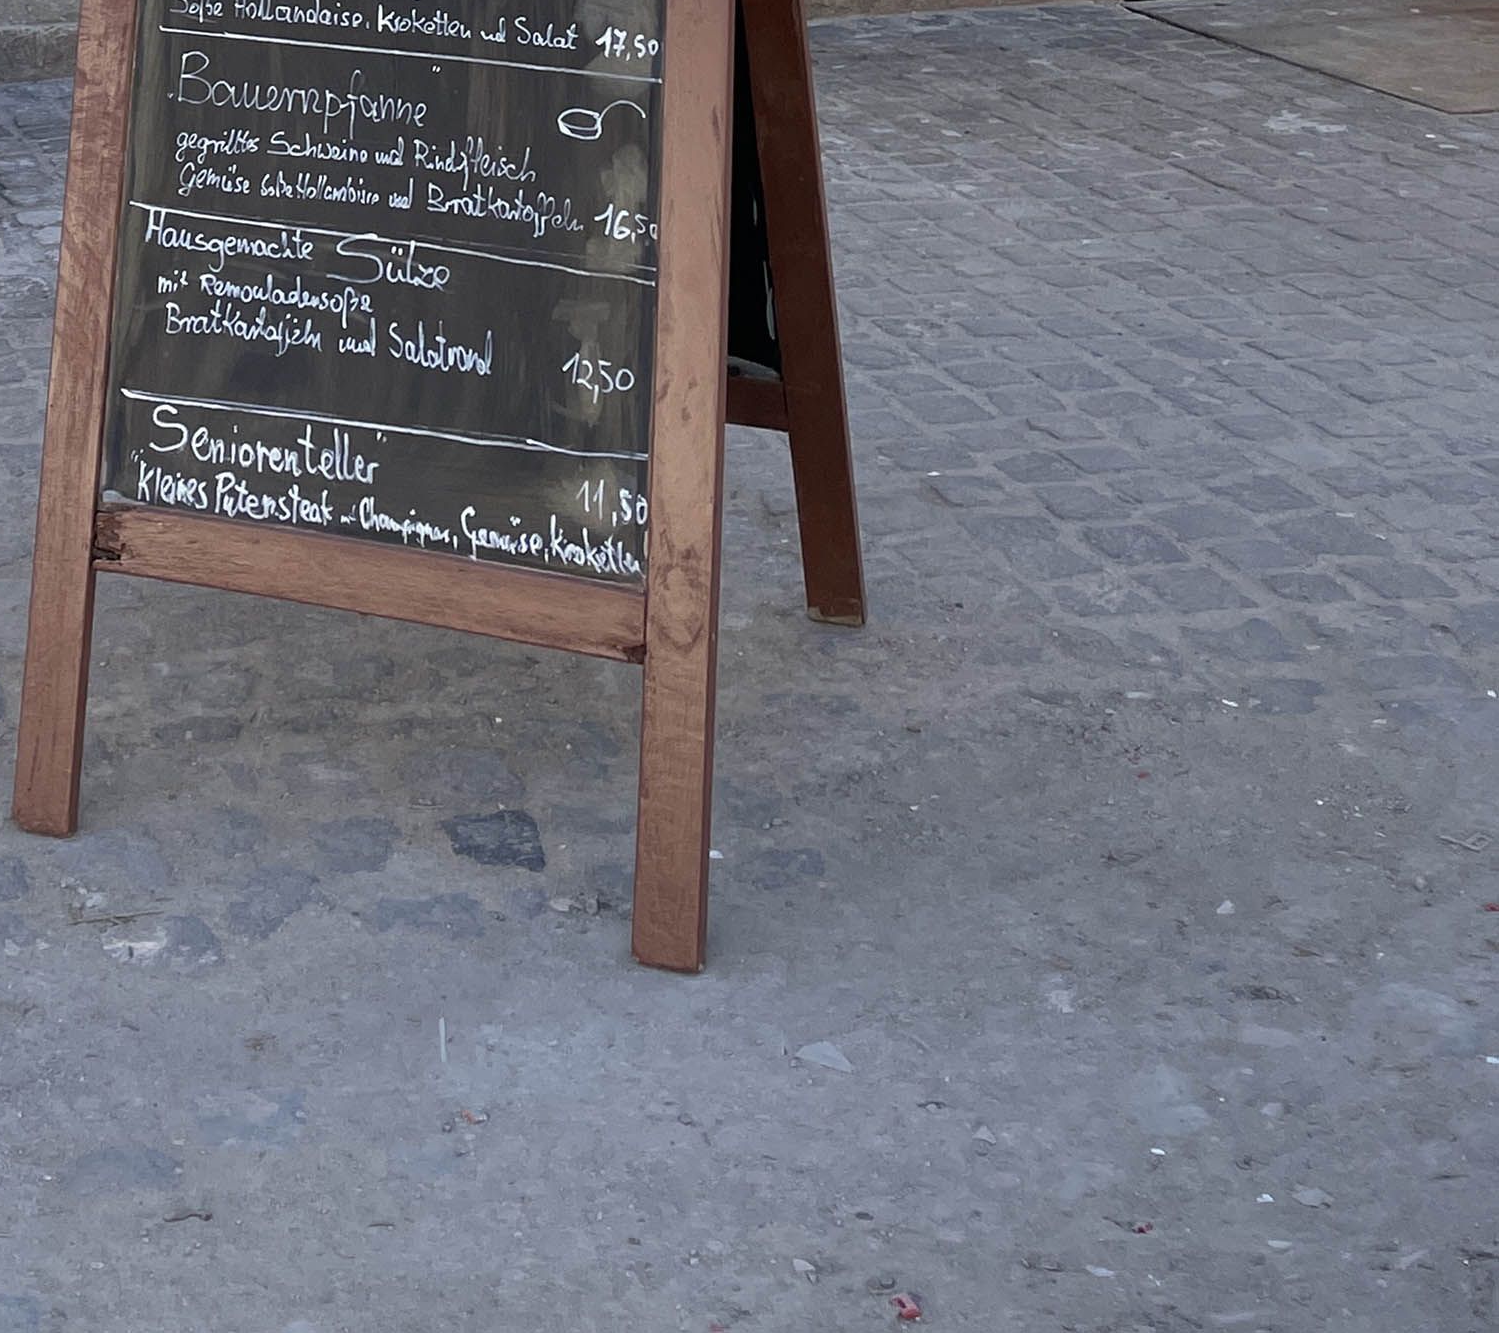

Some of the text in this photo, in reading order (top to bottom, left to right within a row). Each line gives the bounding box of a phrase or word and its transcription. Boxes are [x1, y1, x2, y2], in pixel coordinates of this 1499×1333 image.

[377, 4, 471, 40] Kroketten
[516, 16, 579, 50] Salat
[595, 25, 660, 62] 17,50
[178, 162, 251, 197] Gemüse
[427, 182, 585, 238] Bratkartoffeln
[144, 209, 452, 290] Hausgemachte Sülze
[157, 269, 188, 294] mit
[389, 320, 492, 376] Salatrand
[561, 359, 636, 405] 12,50
[137, 459, 208, 510] Kleines
[576, 479, 649, 527] 11,50
